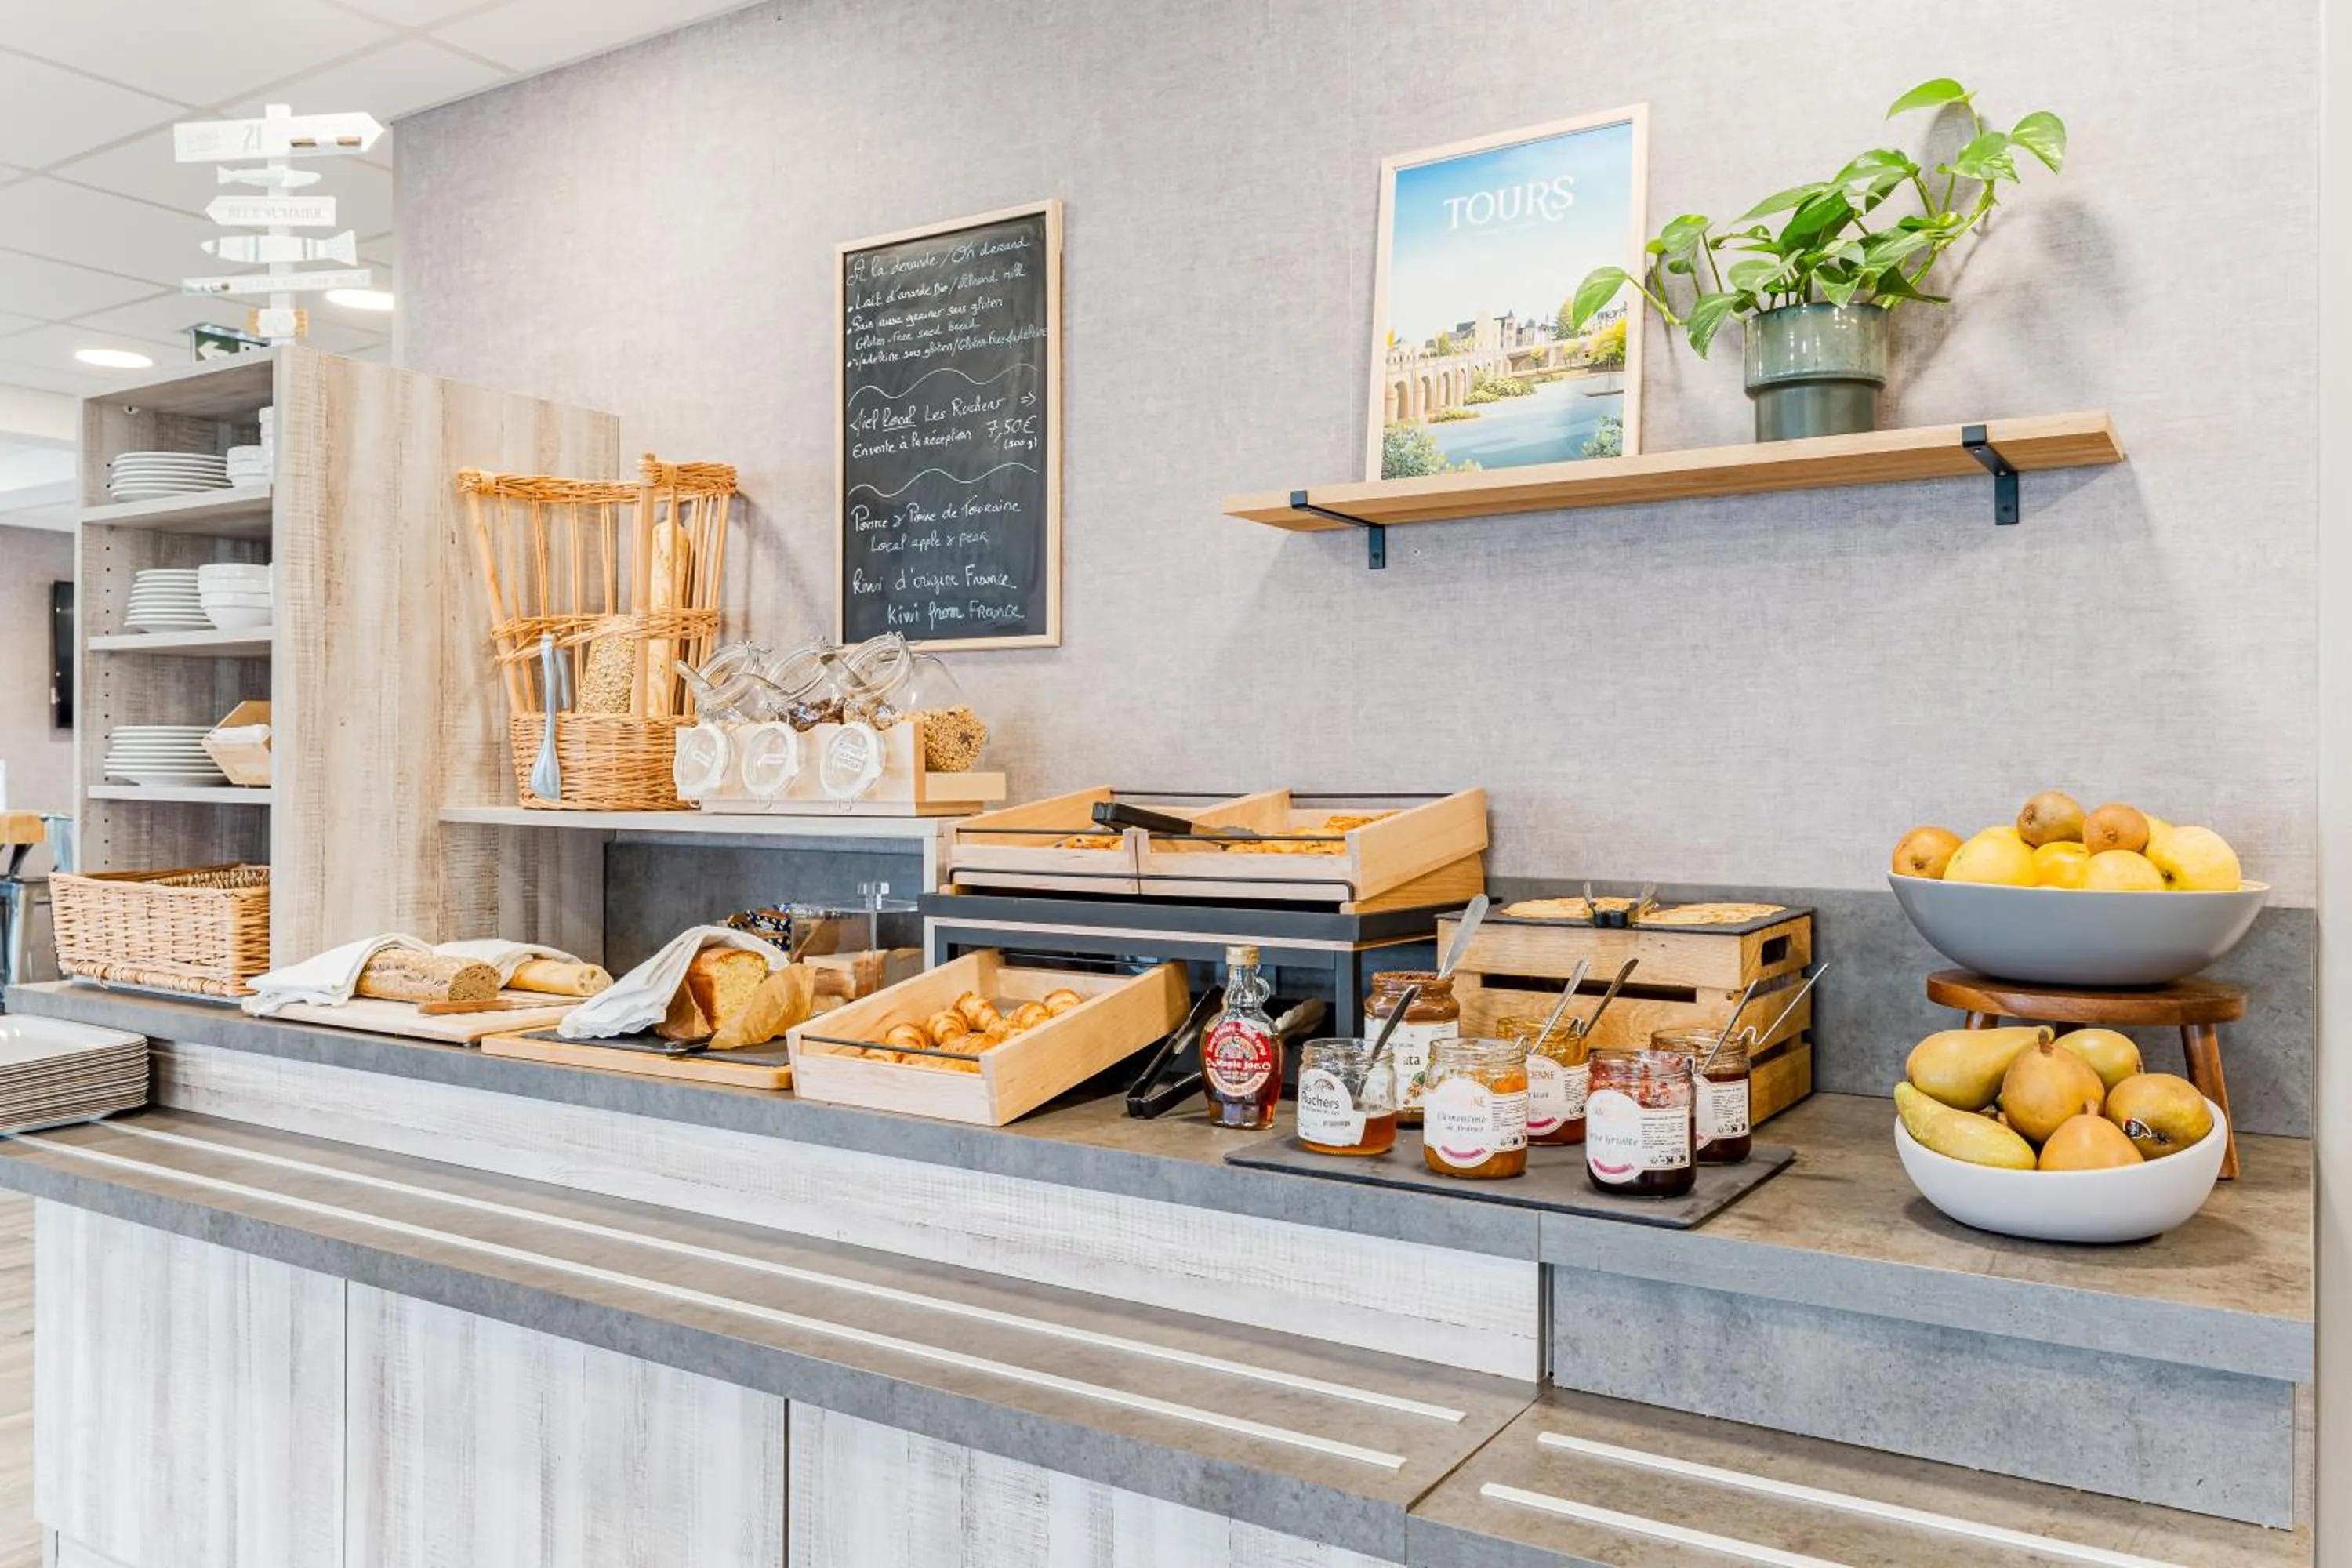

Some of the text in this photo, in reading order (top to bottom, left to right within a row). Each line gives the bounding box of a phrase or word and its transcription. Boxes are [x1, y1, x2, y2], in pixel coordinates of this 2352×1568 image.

[1443, 174, 1574, 230] TOURS
[855, 293, 884, 310] Lait
[924, 404, 946, 422] Les
[942, 502, 958, 520] de
[871, 533, 908, 552] Local
[911, 530, 942, 552] apple
[965, 564, 1017, 589] France
[887, 600, 1025, 631] Kiwi from France
